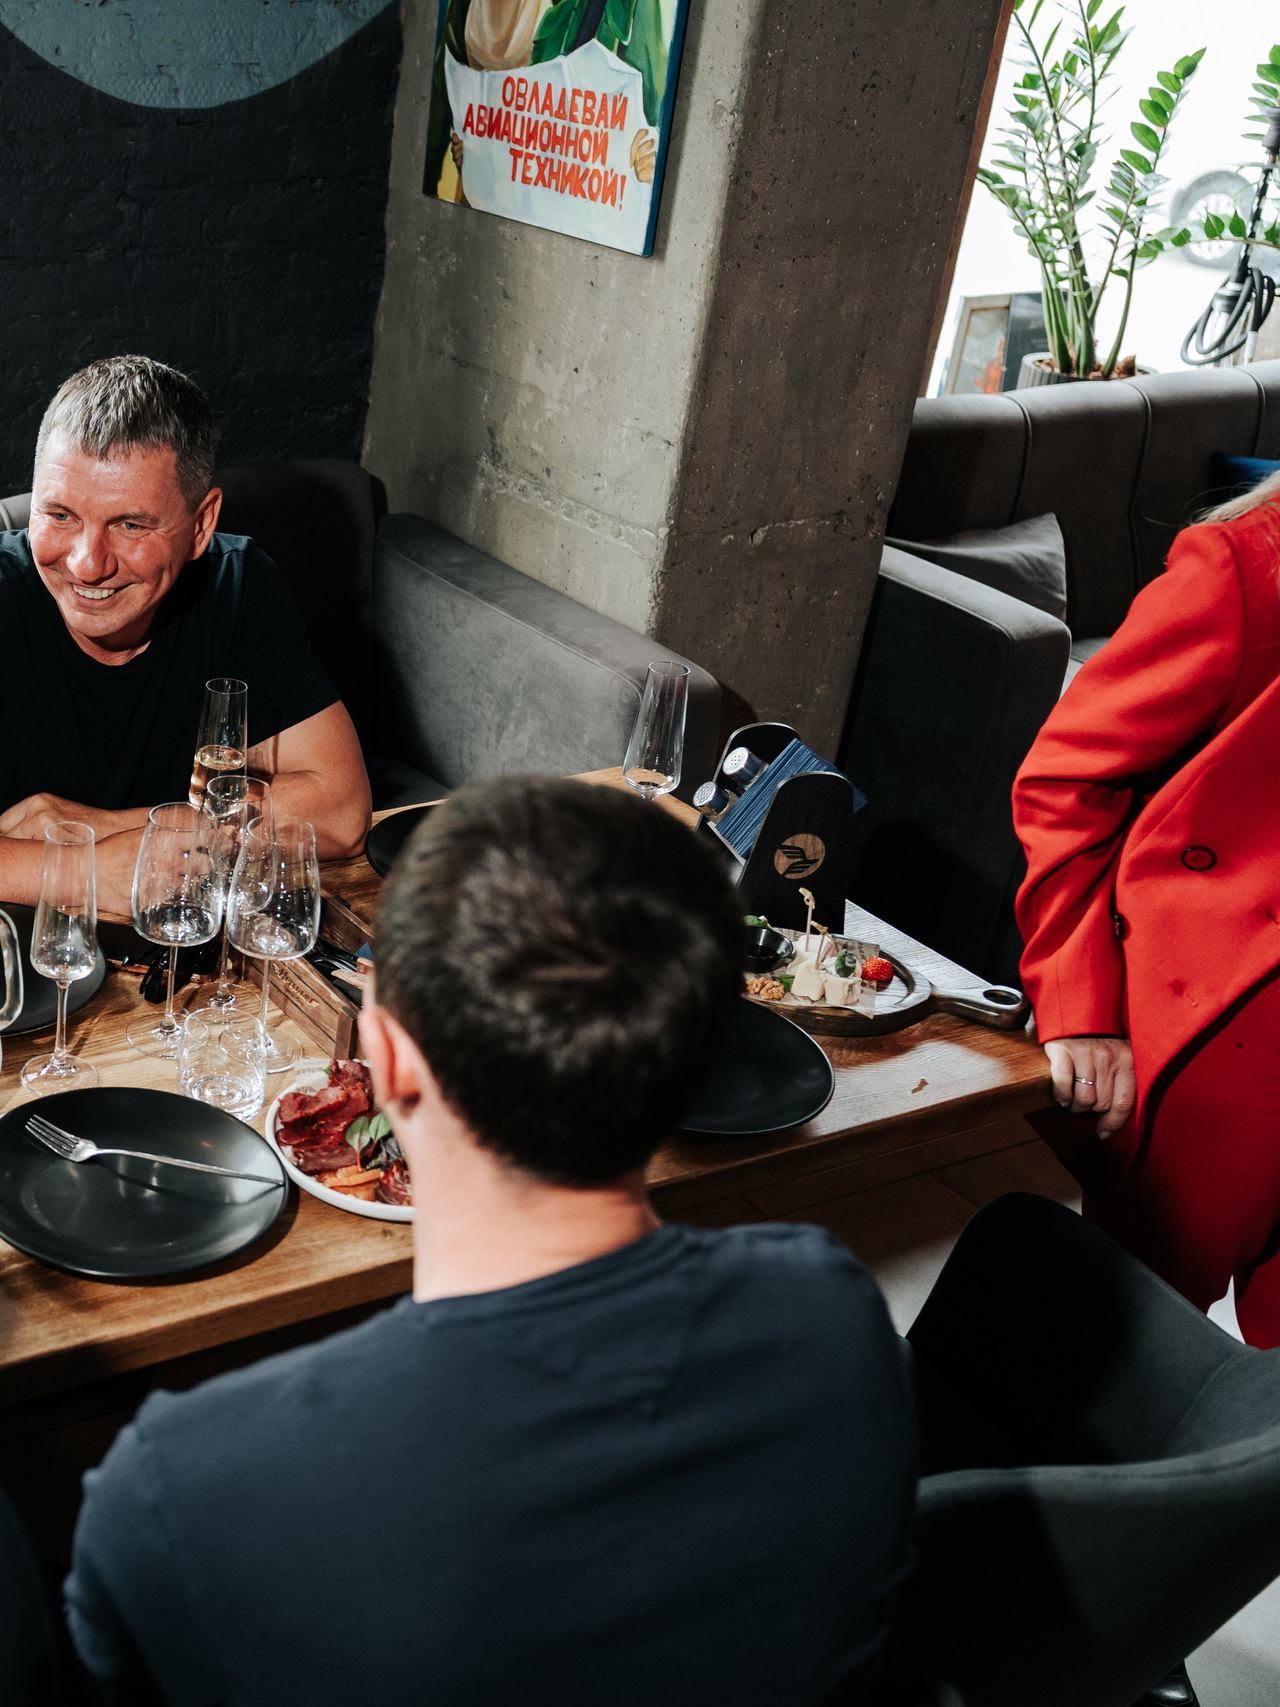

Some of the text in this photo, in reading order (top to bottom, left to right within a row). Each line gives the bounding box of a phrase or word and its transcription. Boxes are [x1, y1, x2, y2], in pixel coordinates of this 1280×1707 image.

[463, 103, 609, 166] АВИАЦИОННОЙ
[502, 76, 628, 131] ОВЛАДЕВАЙ
[509, 148, 627, 211] ТЕХНИКОЙ!
